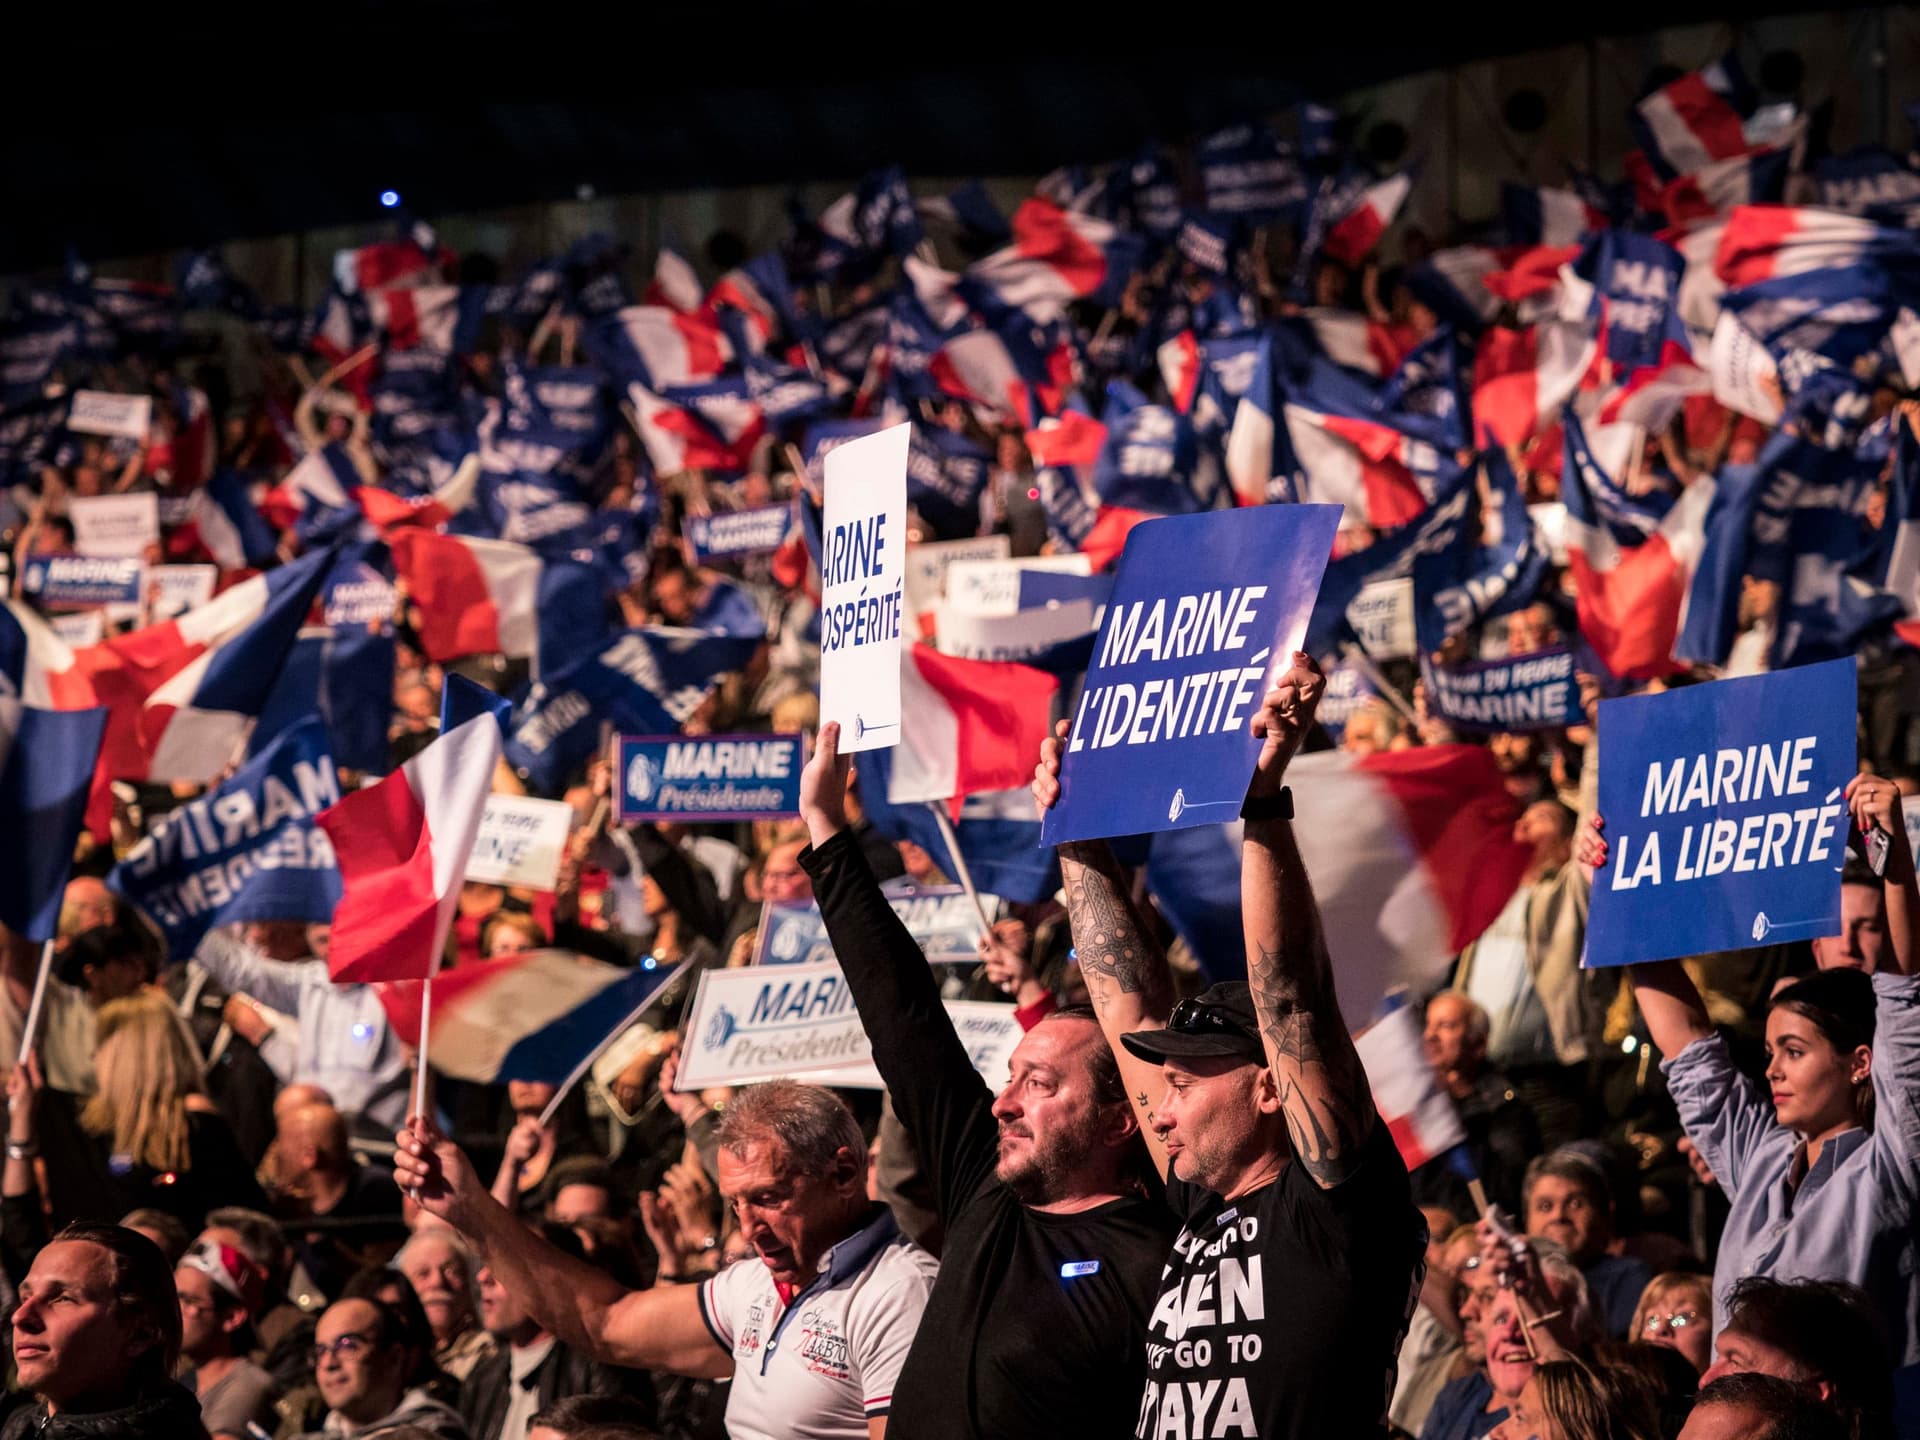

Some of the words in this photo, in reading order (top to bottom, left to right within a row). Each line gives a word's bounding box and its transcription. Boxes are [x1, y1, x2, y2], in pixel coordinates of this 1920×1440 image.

[1100, 586, 1268, 669] MARINE
[1069, 646, 1269, 753] L'IDENTITÉ
[1438, 681, 1569, 722] MARINE
[662, 741, 794, 779] MARINE
[1640, 736, 1817, 818] MARINE
[656, 781, 784, 810] Présidente
[1611, 831, 1662, 892] LA
[1675, 786, 1842, 882] LIBERTÉ
[727, 1028, 866, 1069] Présidente
[1174, 1339, 1212, 1368] GO
[1227, 1334, 1262, 1364] TO
